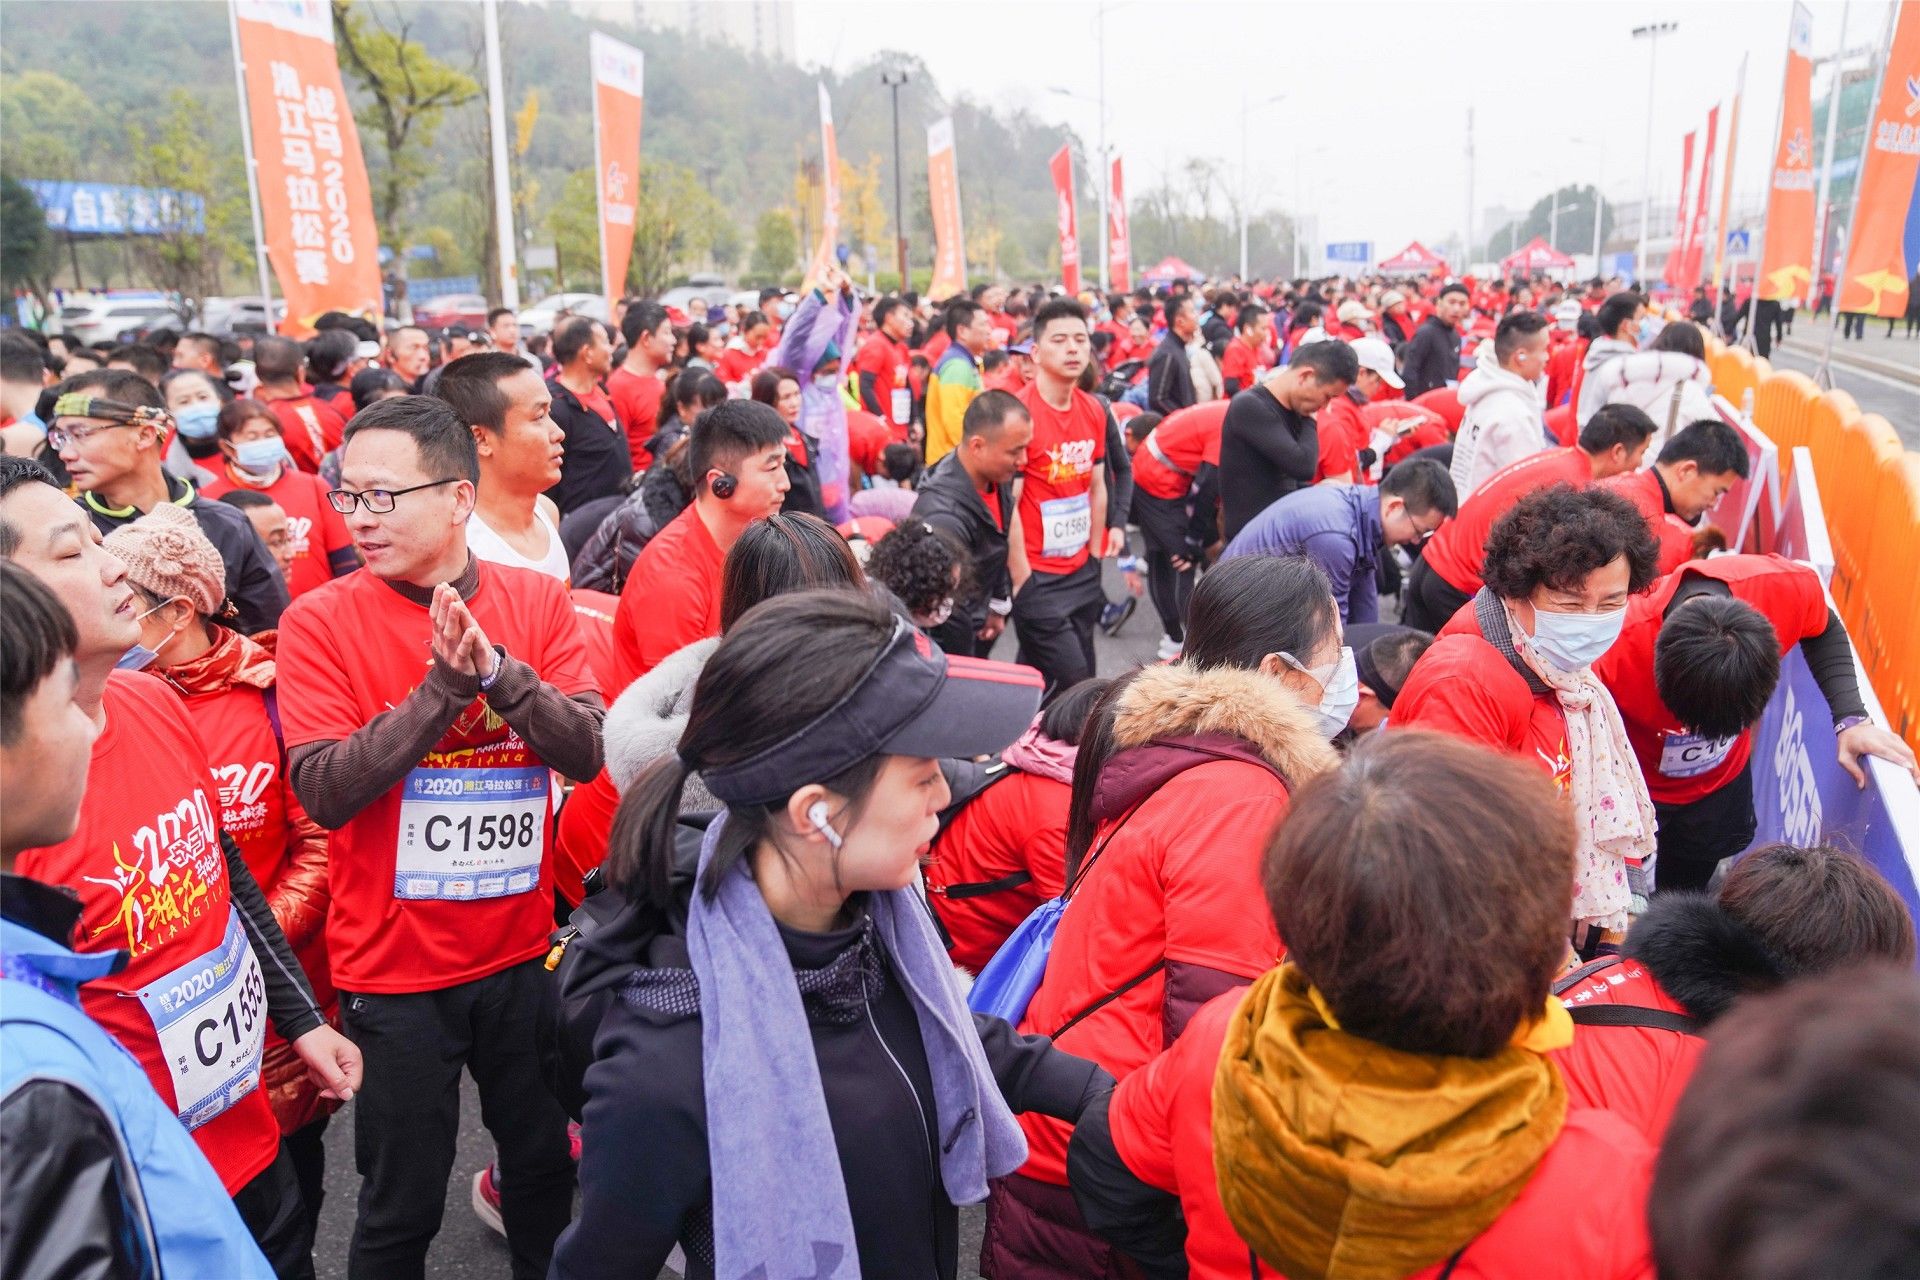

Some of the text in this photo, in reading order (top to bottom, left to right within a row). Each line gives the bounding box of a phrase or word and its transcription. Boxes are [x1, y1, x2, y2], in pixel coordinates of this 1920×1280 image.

[423, 777, 464, 796] 2020
[463, 779, 523, 792] 湘江马拉松赛
[425, 811, 534, 852] C1598
[143, 868, 208, 931] 湘江
[170, 968, 215, 1010] 2020
[194, 960, 263, 1068] C1555
